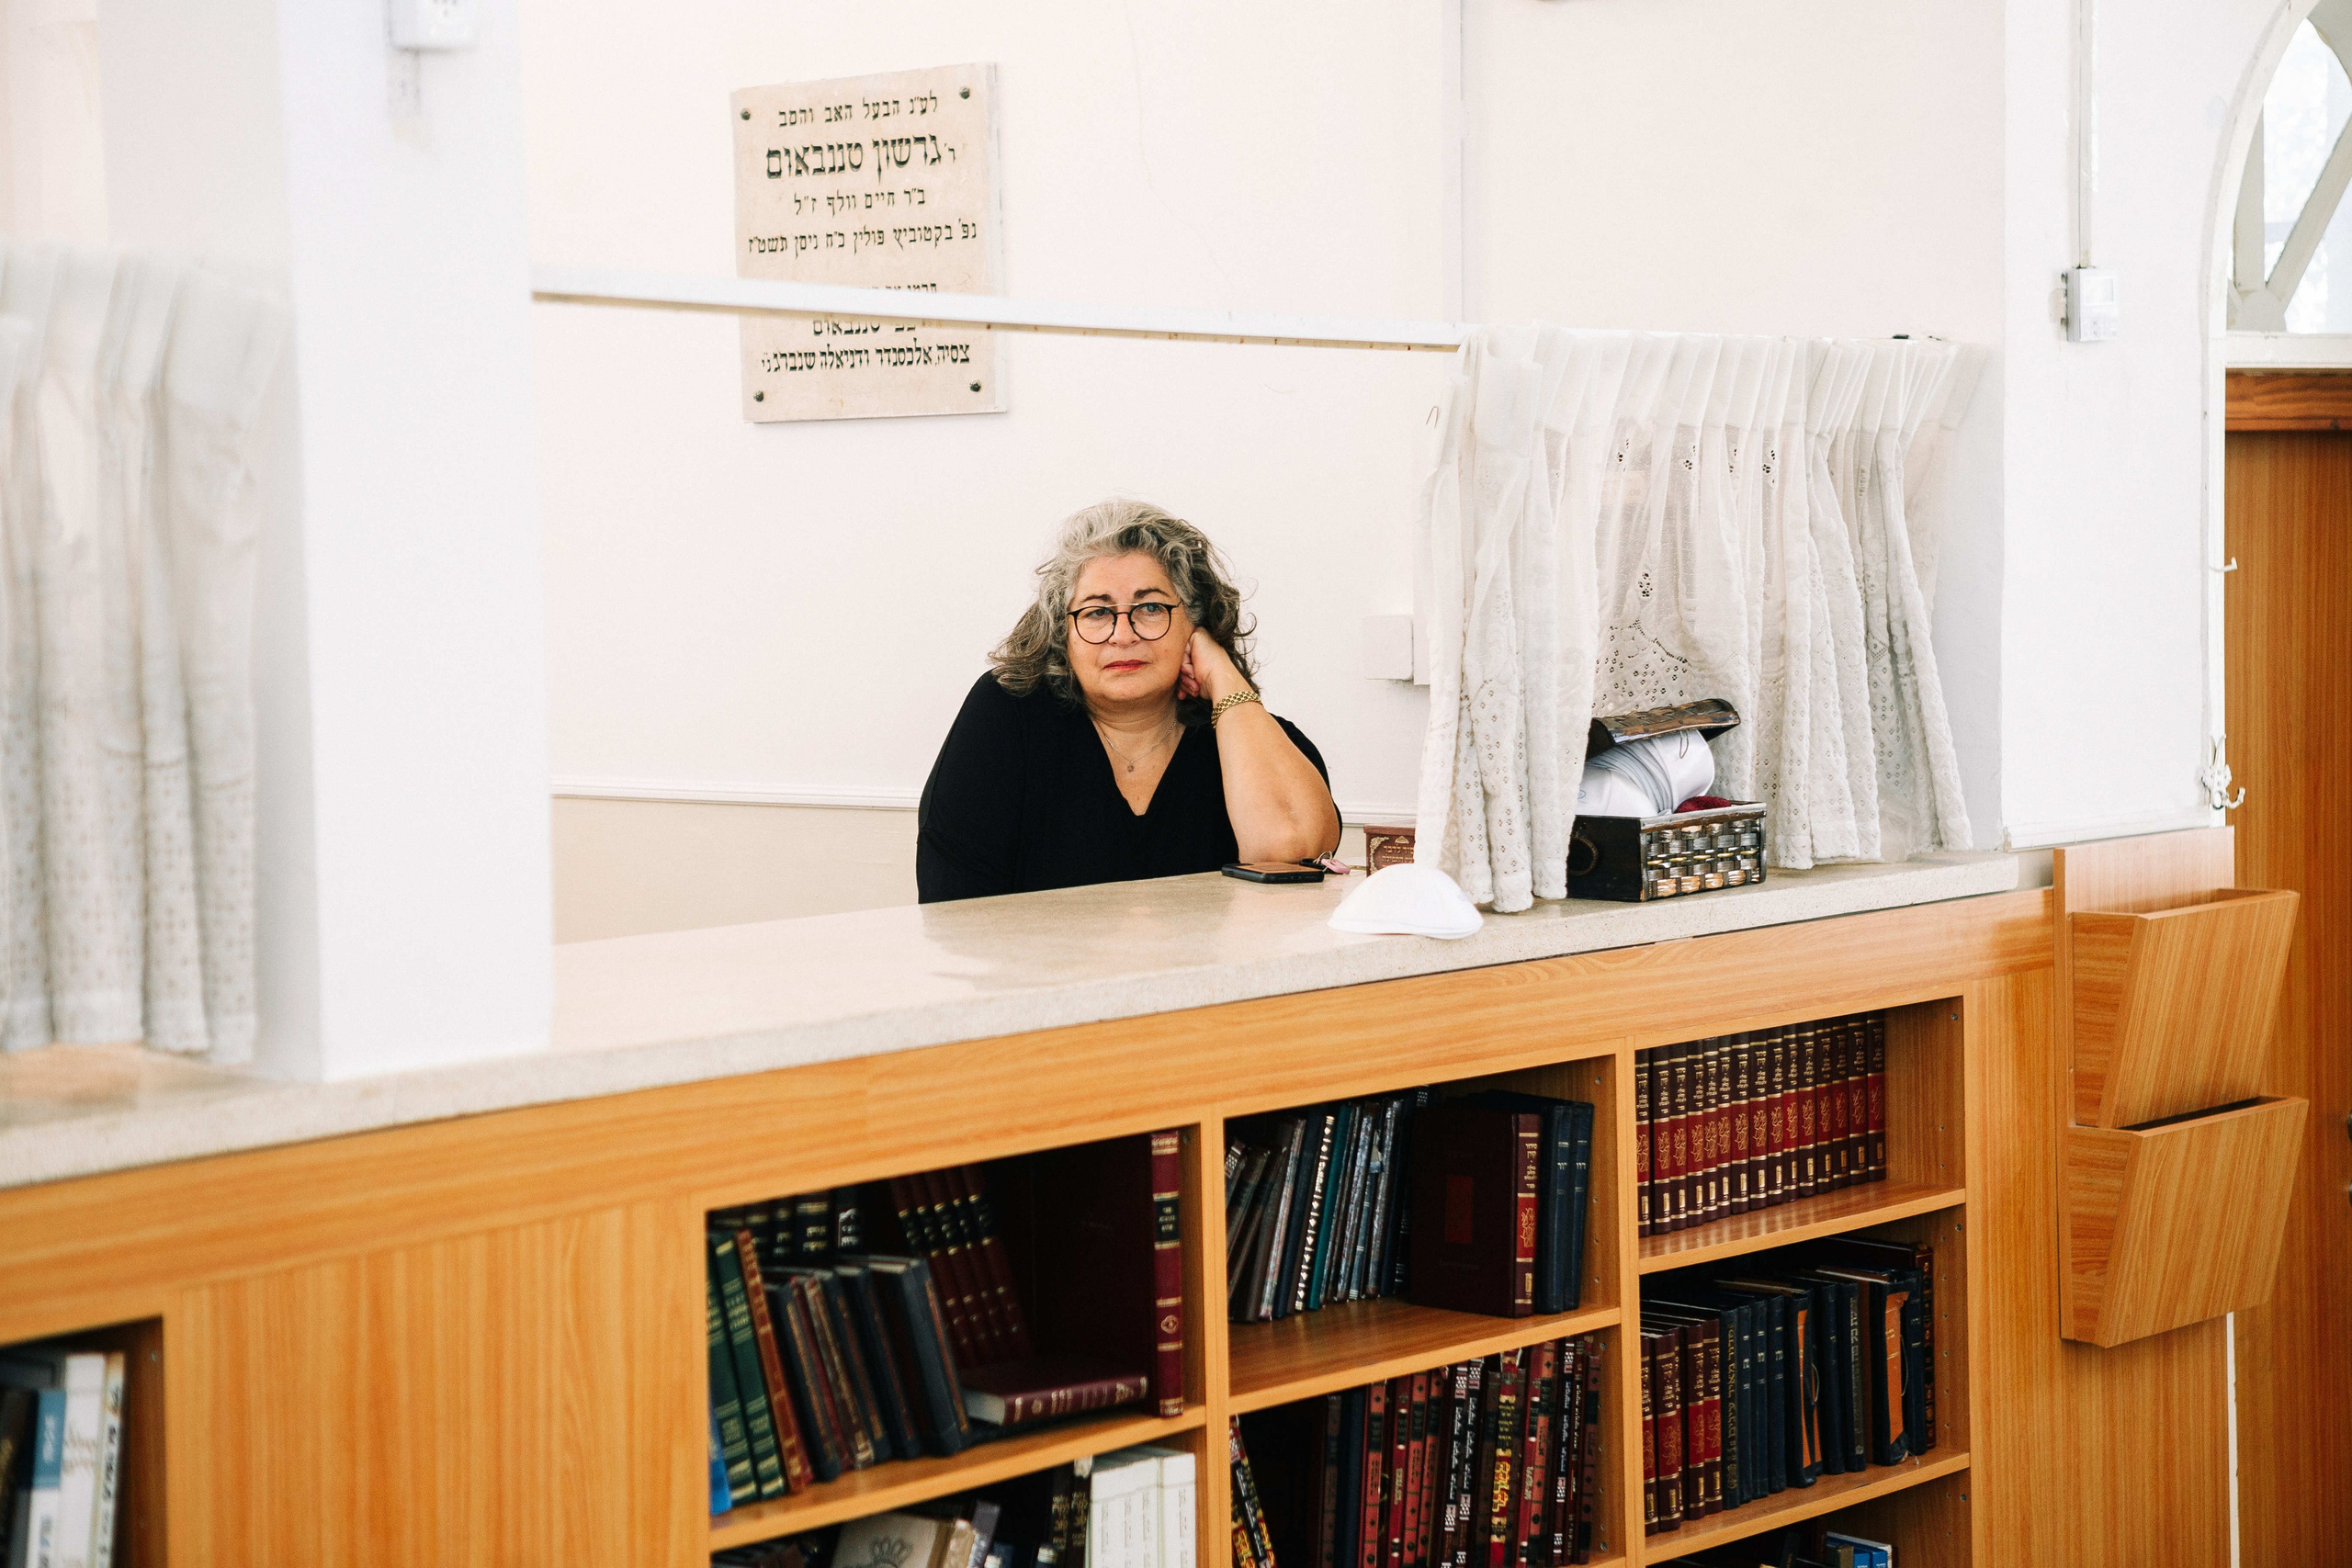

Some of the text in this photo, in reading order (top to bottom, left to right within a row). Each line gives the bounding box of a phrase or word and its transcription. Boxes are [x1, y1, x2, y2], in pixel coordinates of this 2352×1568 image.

[778, 108, 814, 127] והסב
[825, 104, 852, 122] האב
[863, 96, 899, 120] הבעל
[766, 142, 864, 179] טננבאום
[872, 133, 941, 185] גרשון
[794, 187, 925, 217] ב"ר חיים וולף ז"ל
[795, 233, 818, 260] ניסן
[854, 224, 885, 255] פולין
[893, 224, 953, 251] בקטוביץ
[773, 350, 816, 372] שנברג
[819, 343, 869, 370] ודניאלה
[875, 337, 933, 367] אלכסנדר
